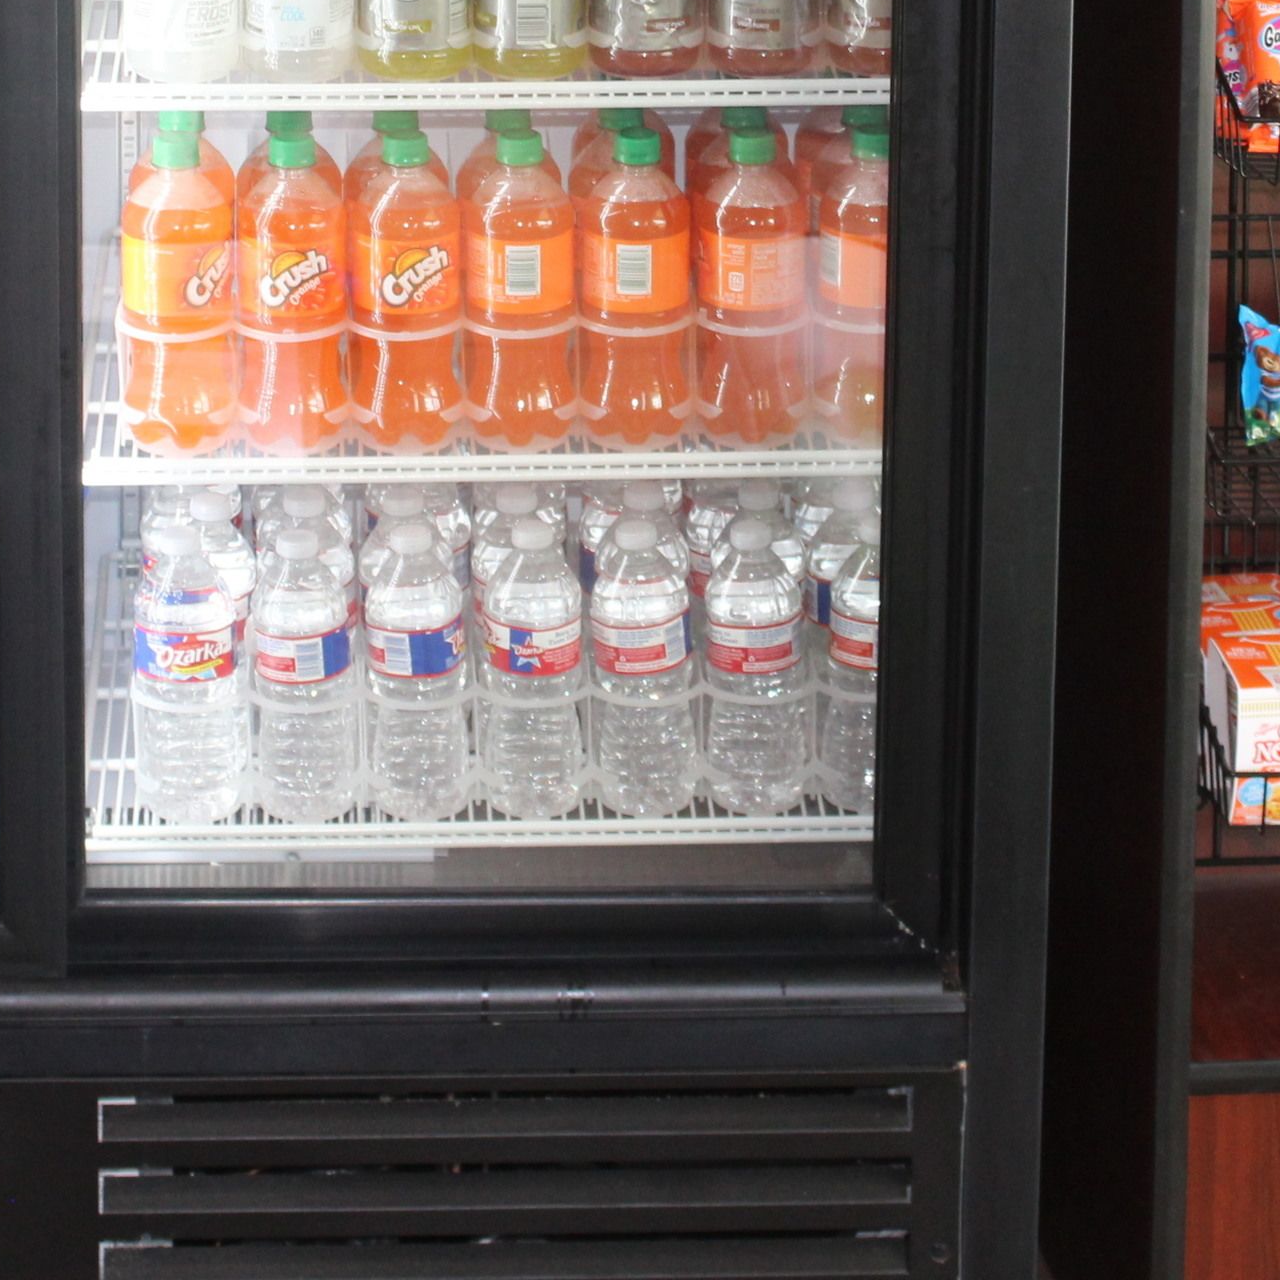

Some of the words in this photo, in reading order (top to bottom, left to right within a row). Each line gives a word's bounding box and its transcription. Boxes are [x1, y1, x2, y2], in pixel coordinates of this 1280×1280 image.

[260, 246, 329, 308] Crush
[381, 246, 450, 308] Crush
[156, 638, 232, 669] Ozarka
